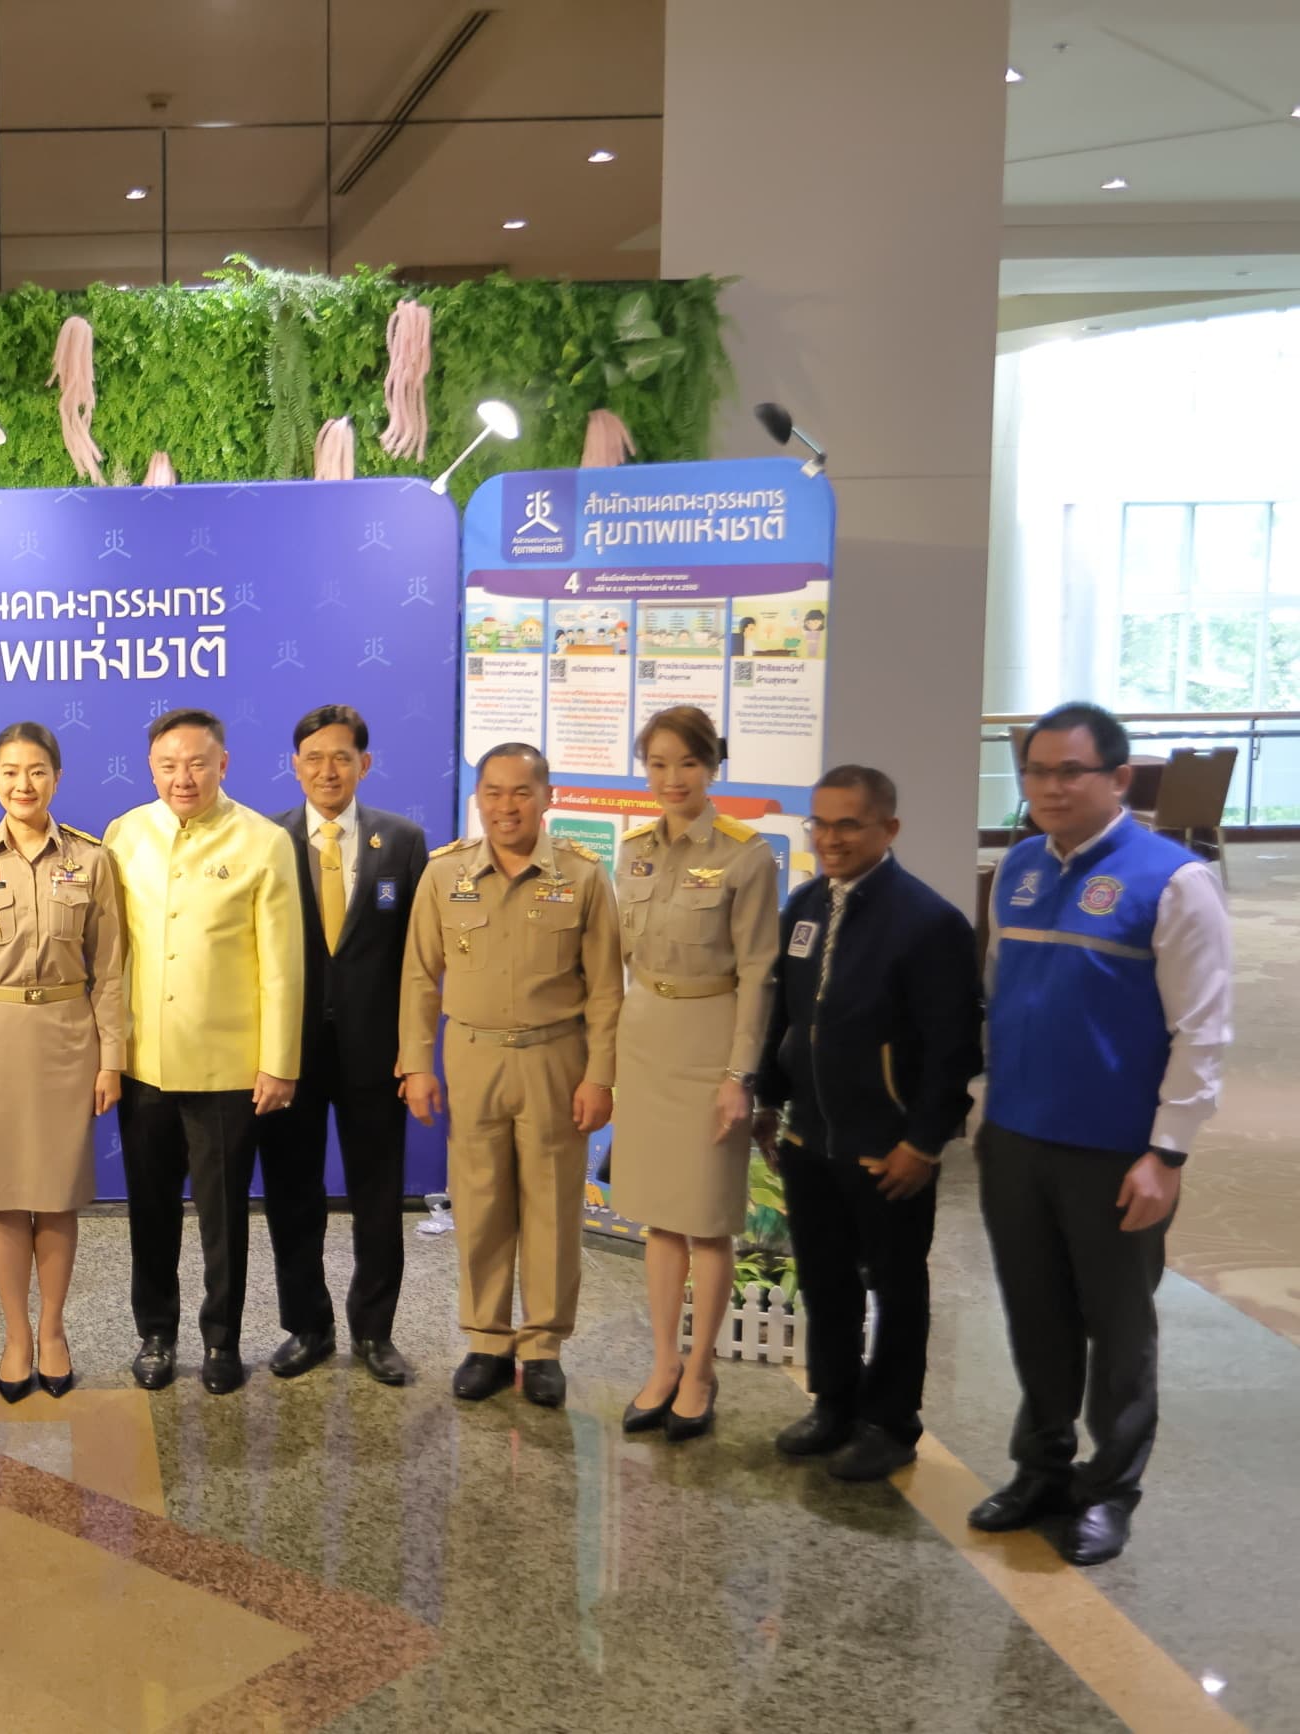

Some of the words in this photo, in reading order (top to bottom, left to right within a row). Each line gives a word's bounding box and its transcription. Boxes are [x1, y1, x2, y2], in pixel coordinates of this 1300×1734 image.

[584, 490, 785, 515] สำนักงานคณะกรรมการ
[584, 509, 785, 554] สุขภาพแห่งชาติ
[564, 571, 580, 594] 4
